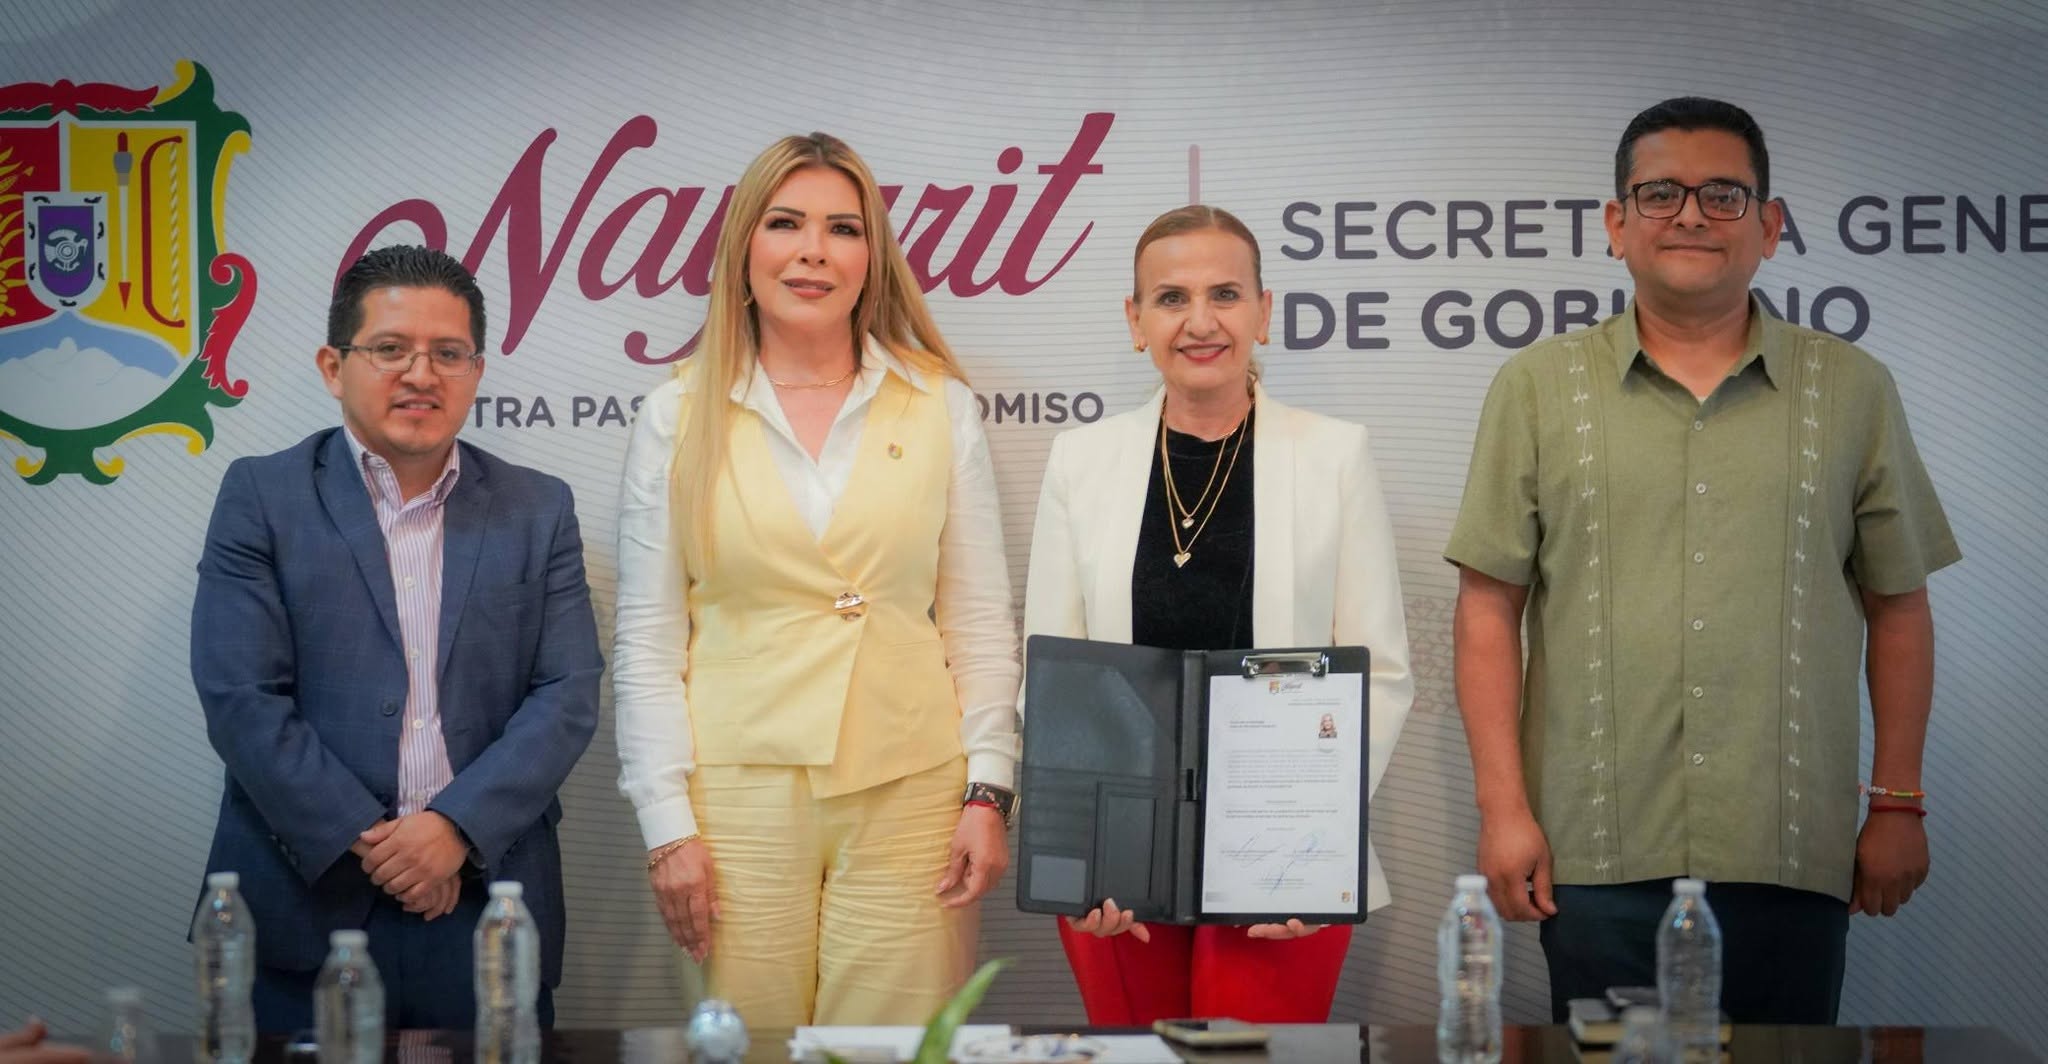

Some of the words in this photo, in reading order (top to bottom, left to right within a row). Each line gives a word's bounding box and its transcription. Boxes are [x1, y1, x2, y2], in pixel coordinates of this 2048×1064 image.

[332, 112, 1116, 366] Nayrit
[1281, 197, 1807, 261] SECRETA
[1838, 194, 2048, 256] GENE
[1284, 291, 1390, 350] DE
[1421, 286, 1872, 350] GOBINO
